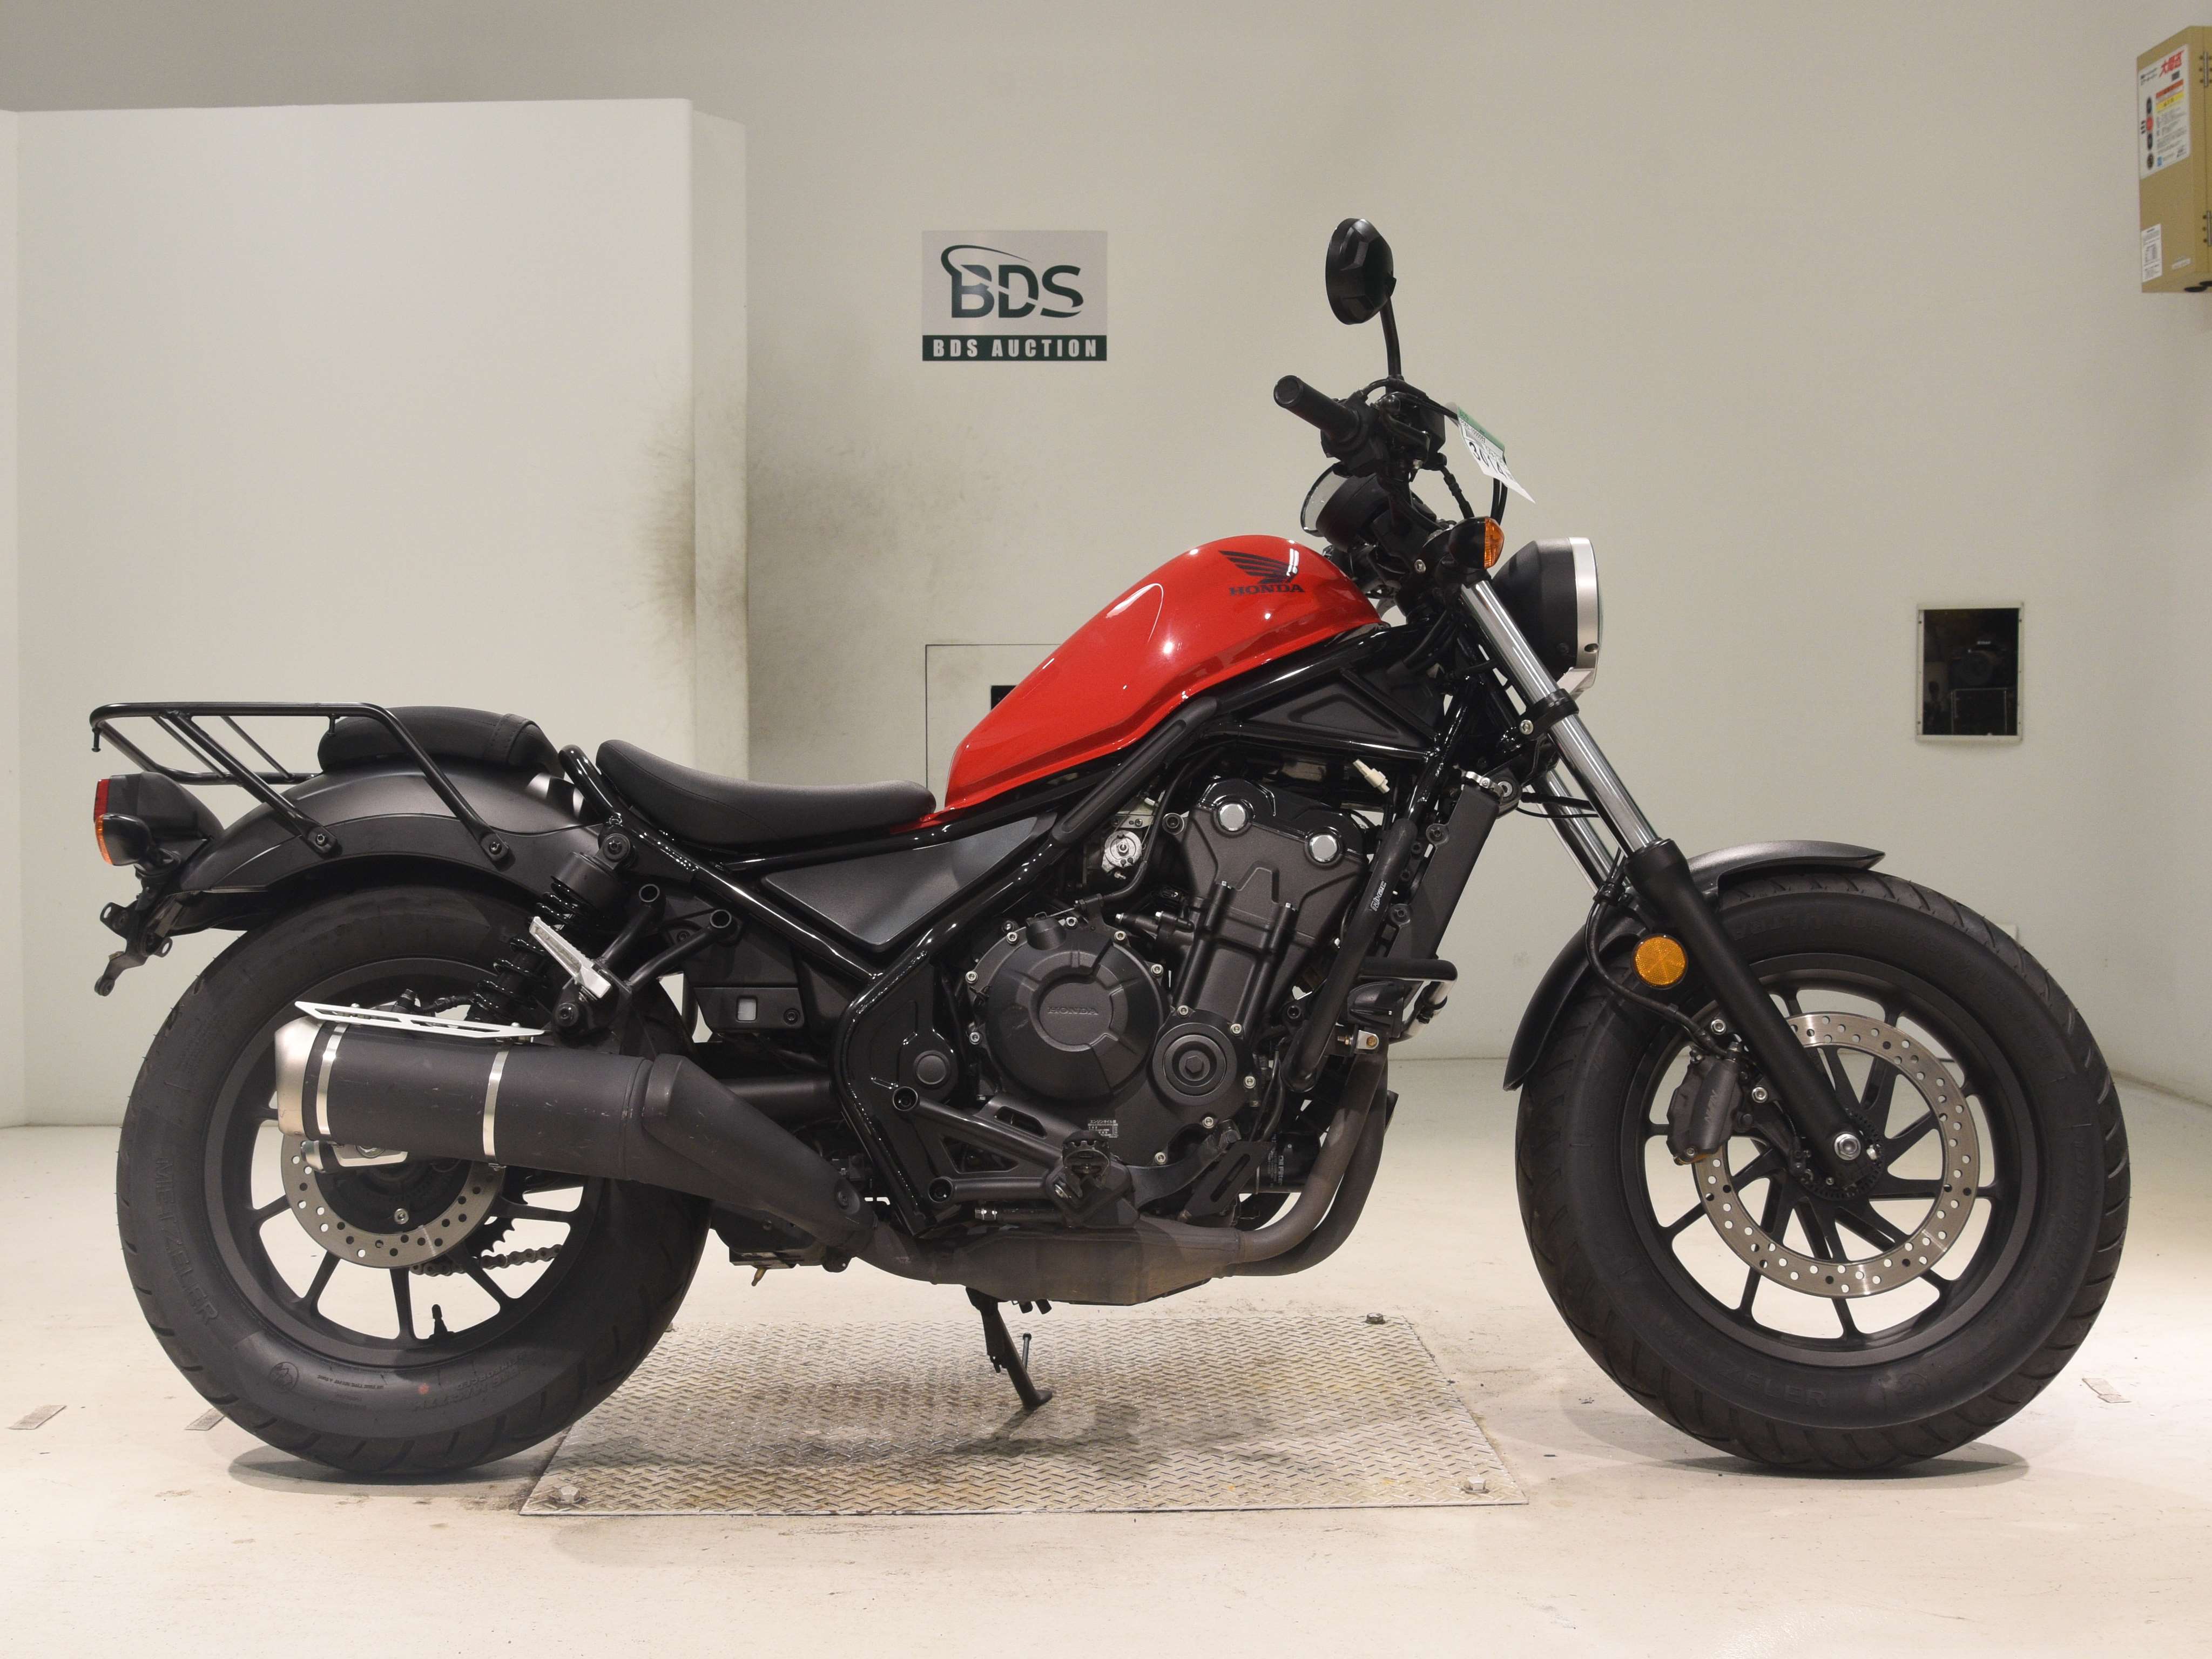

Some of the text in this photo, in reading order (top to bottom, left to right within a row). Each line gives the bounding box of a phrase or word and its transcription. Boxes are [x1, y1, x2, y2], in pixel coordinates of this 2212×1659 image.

[942, 249, 1084, 318] BDS
[933, 339, 1096, 357] BDS AUCTION
[1229, 584, 1305, 596] HONDA
[1048, 1007, 1099, 1015] HONDA
